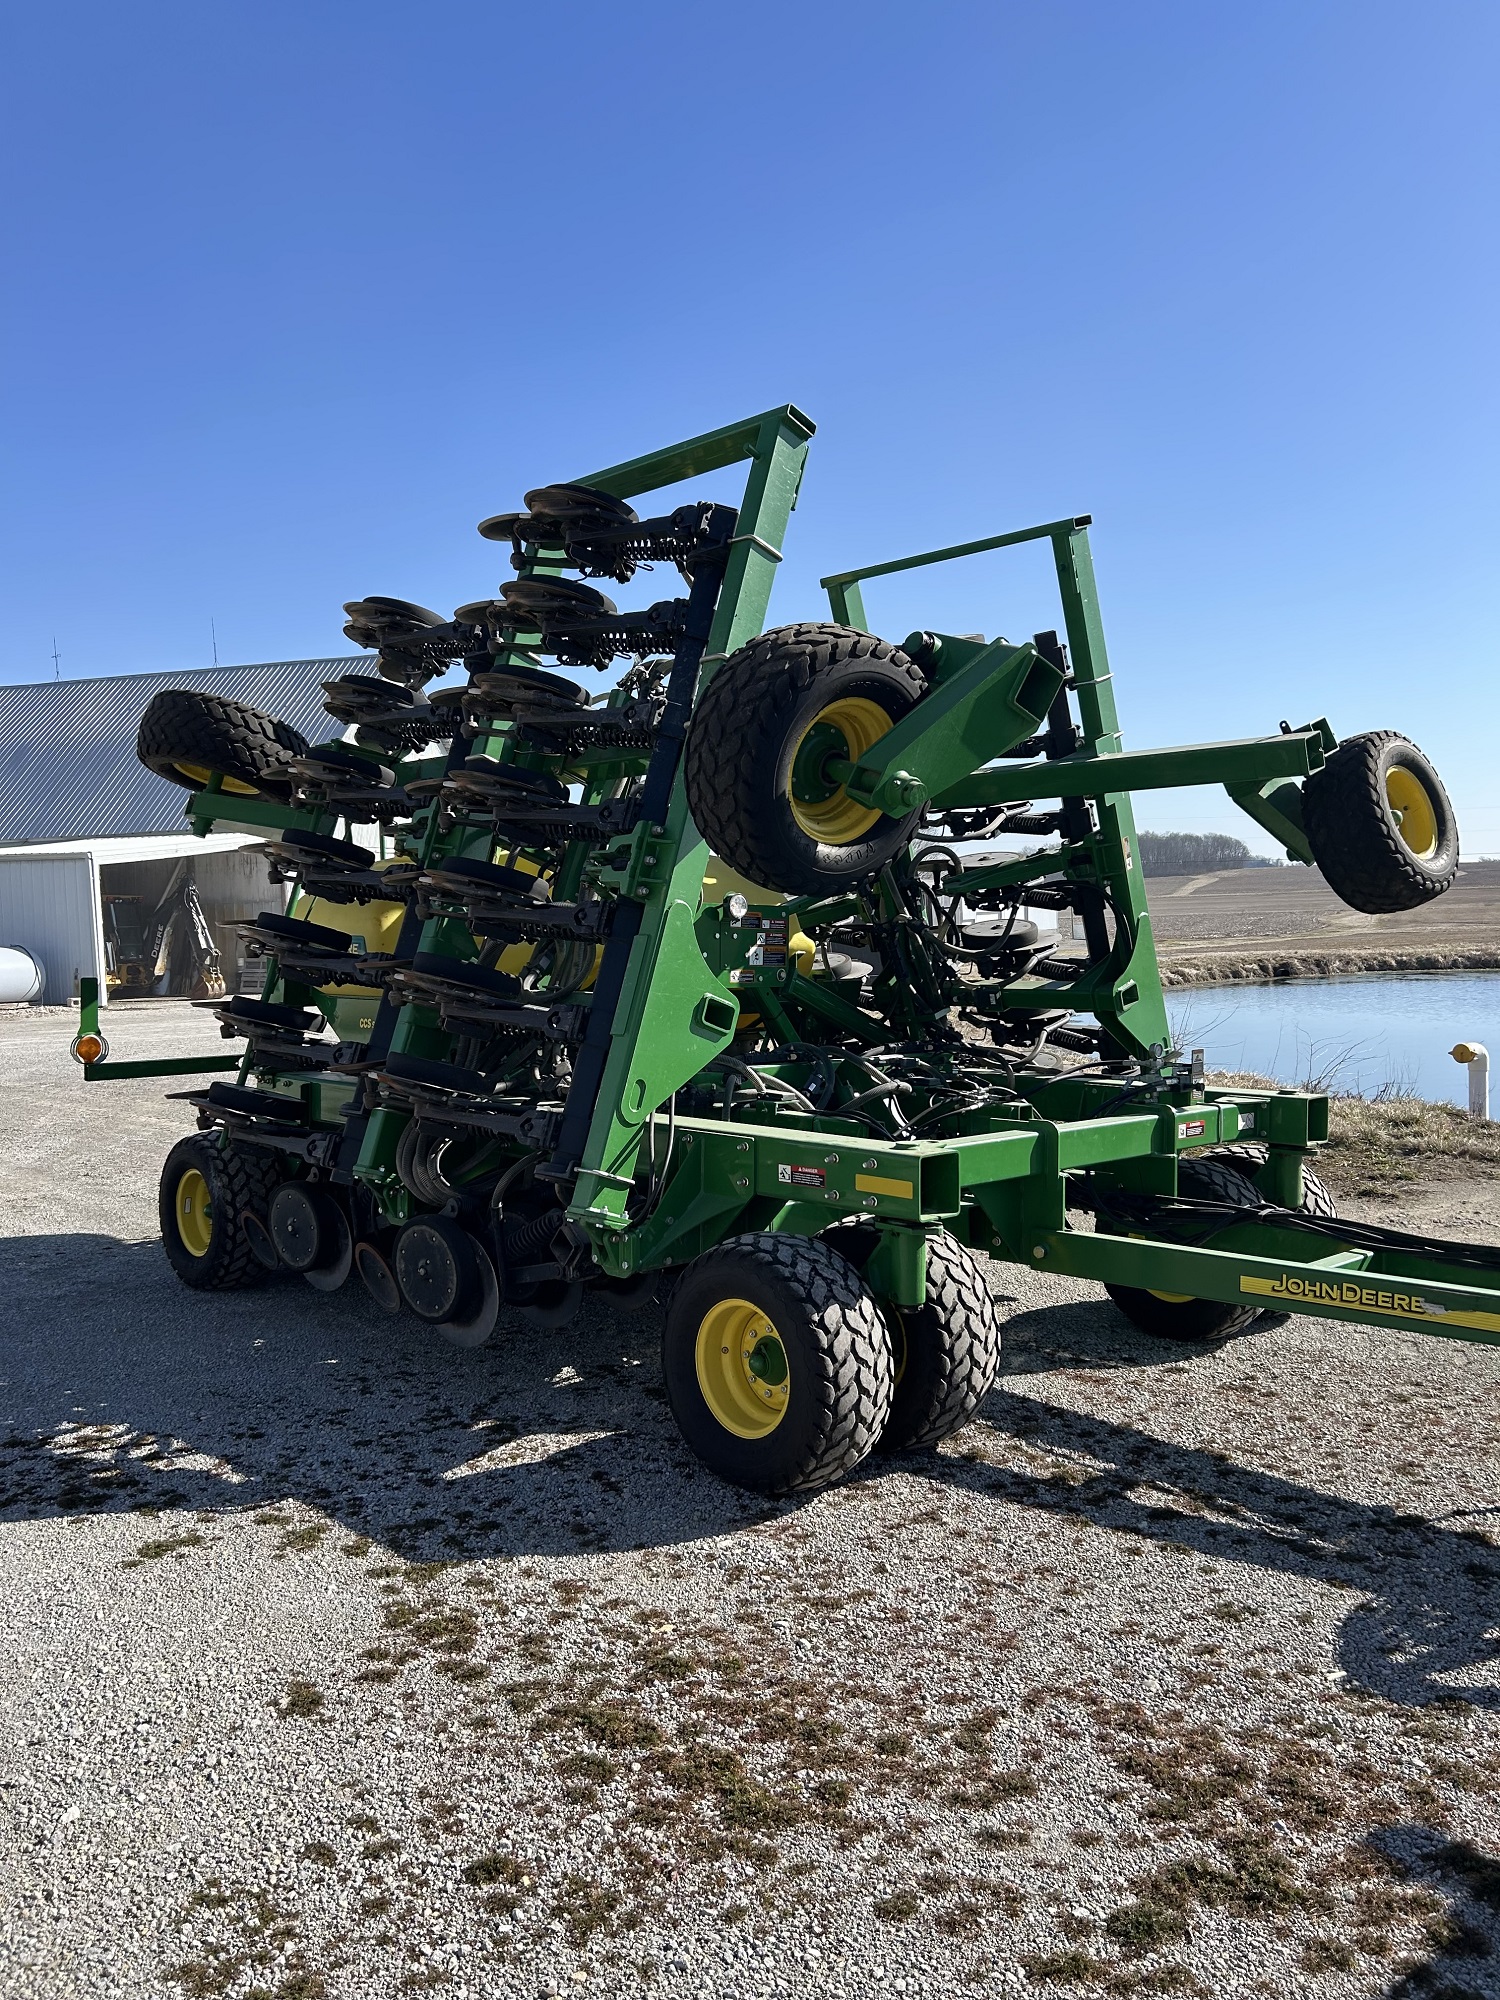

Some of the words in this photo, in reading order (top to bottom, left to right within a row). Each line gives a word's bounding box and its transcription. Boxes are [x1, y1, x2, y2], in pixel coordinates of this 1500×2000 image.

[151, 923, 164, 958] DEERE
[359, 1018, 372, 1029] CCS
[1273, 1274, 1340, 1300] JOHN
[1342, 1283, 1425, 1313] DEERE
